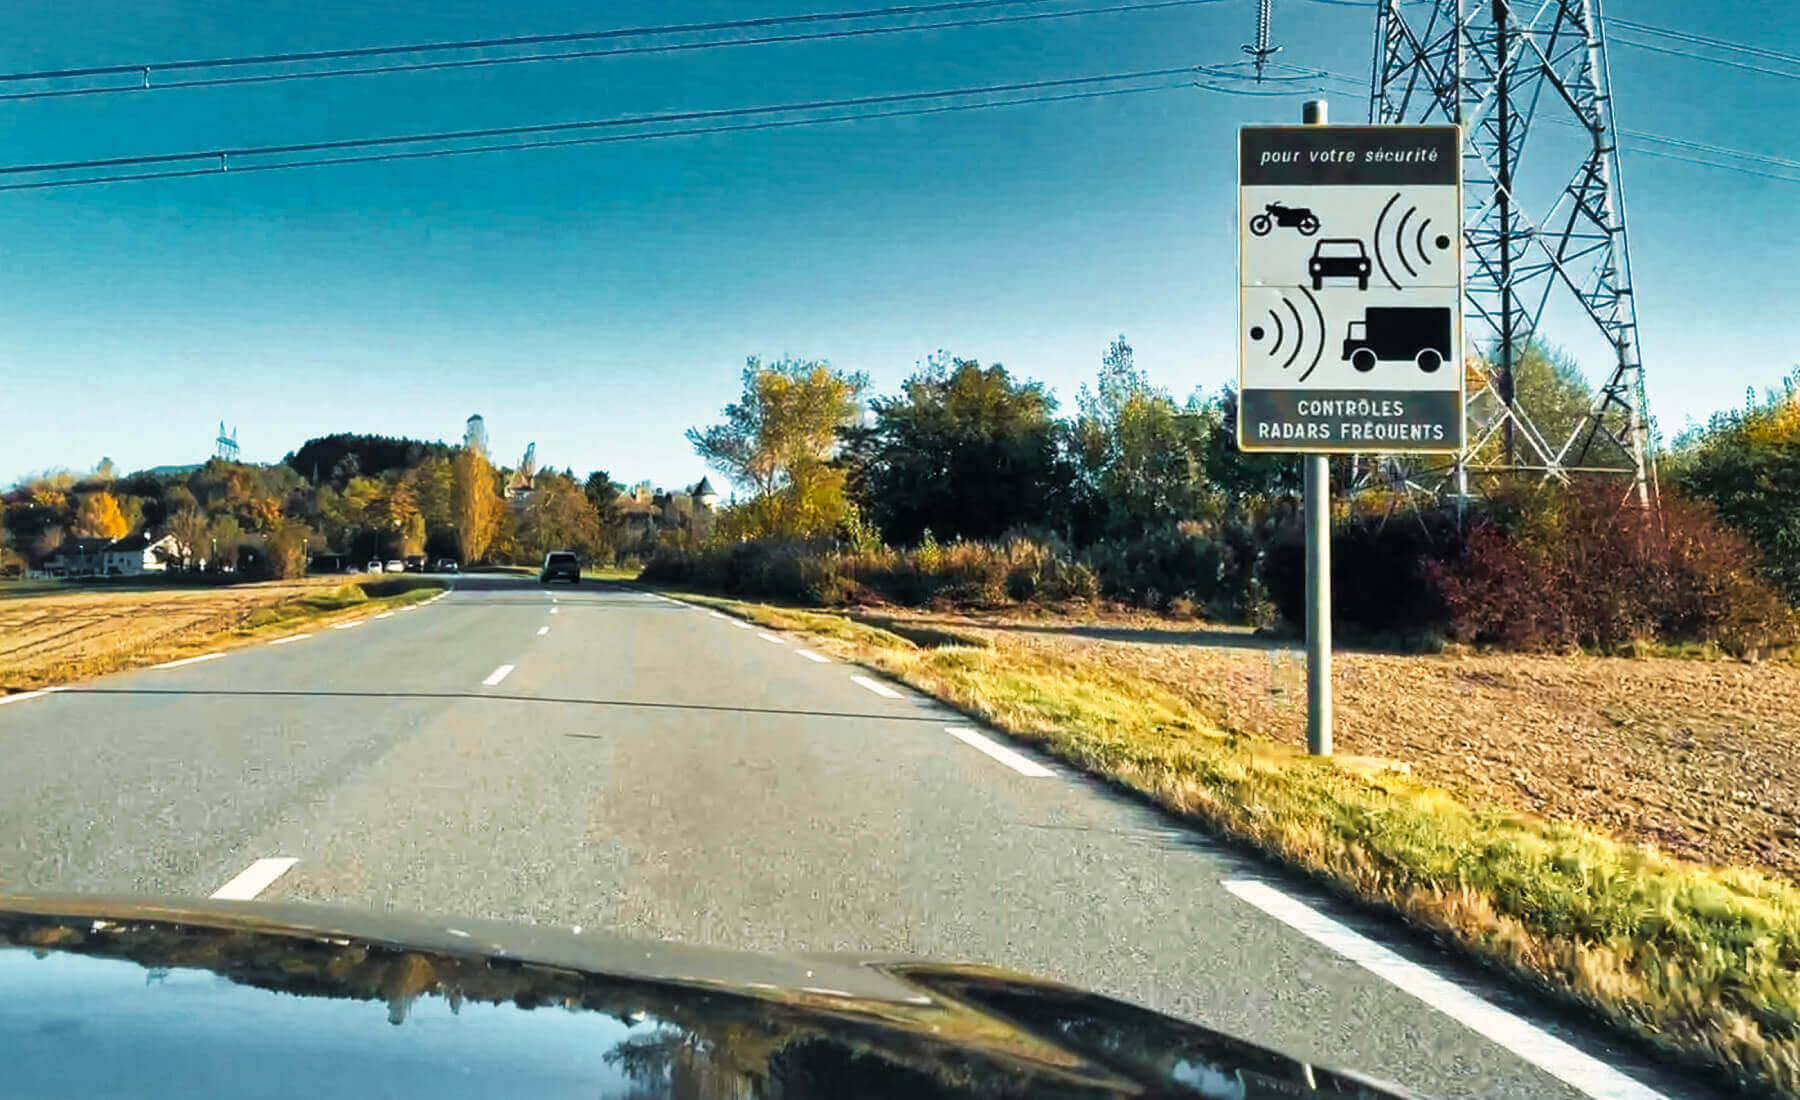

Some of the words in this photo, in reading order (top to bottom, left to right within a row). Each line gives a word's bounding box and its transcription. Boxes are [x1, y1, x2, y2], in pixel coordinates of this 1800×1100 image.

[1260, 150, 1300, 166] pour
[1309, 148, 1356, 163] votre
[1365, 147, 1439, 163] sécurité
[1297, 398, 1404, 416] CONTRÔLES
[1258, 422, 1331, 440] RADARS
[1340, 421, 1444, 441] FRÉQUENTS
